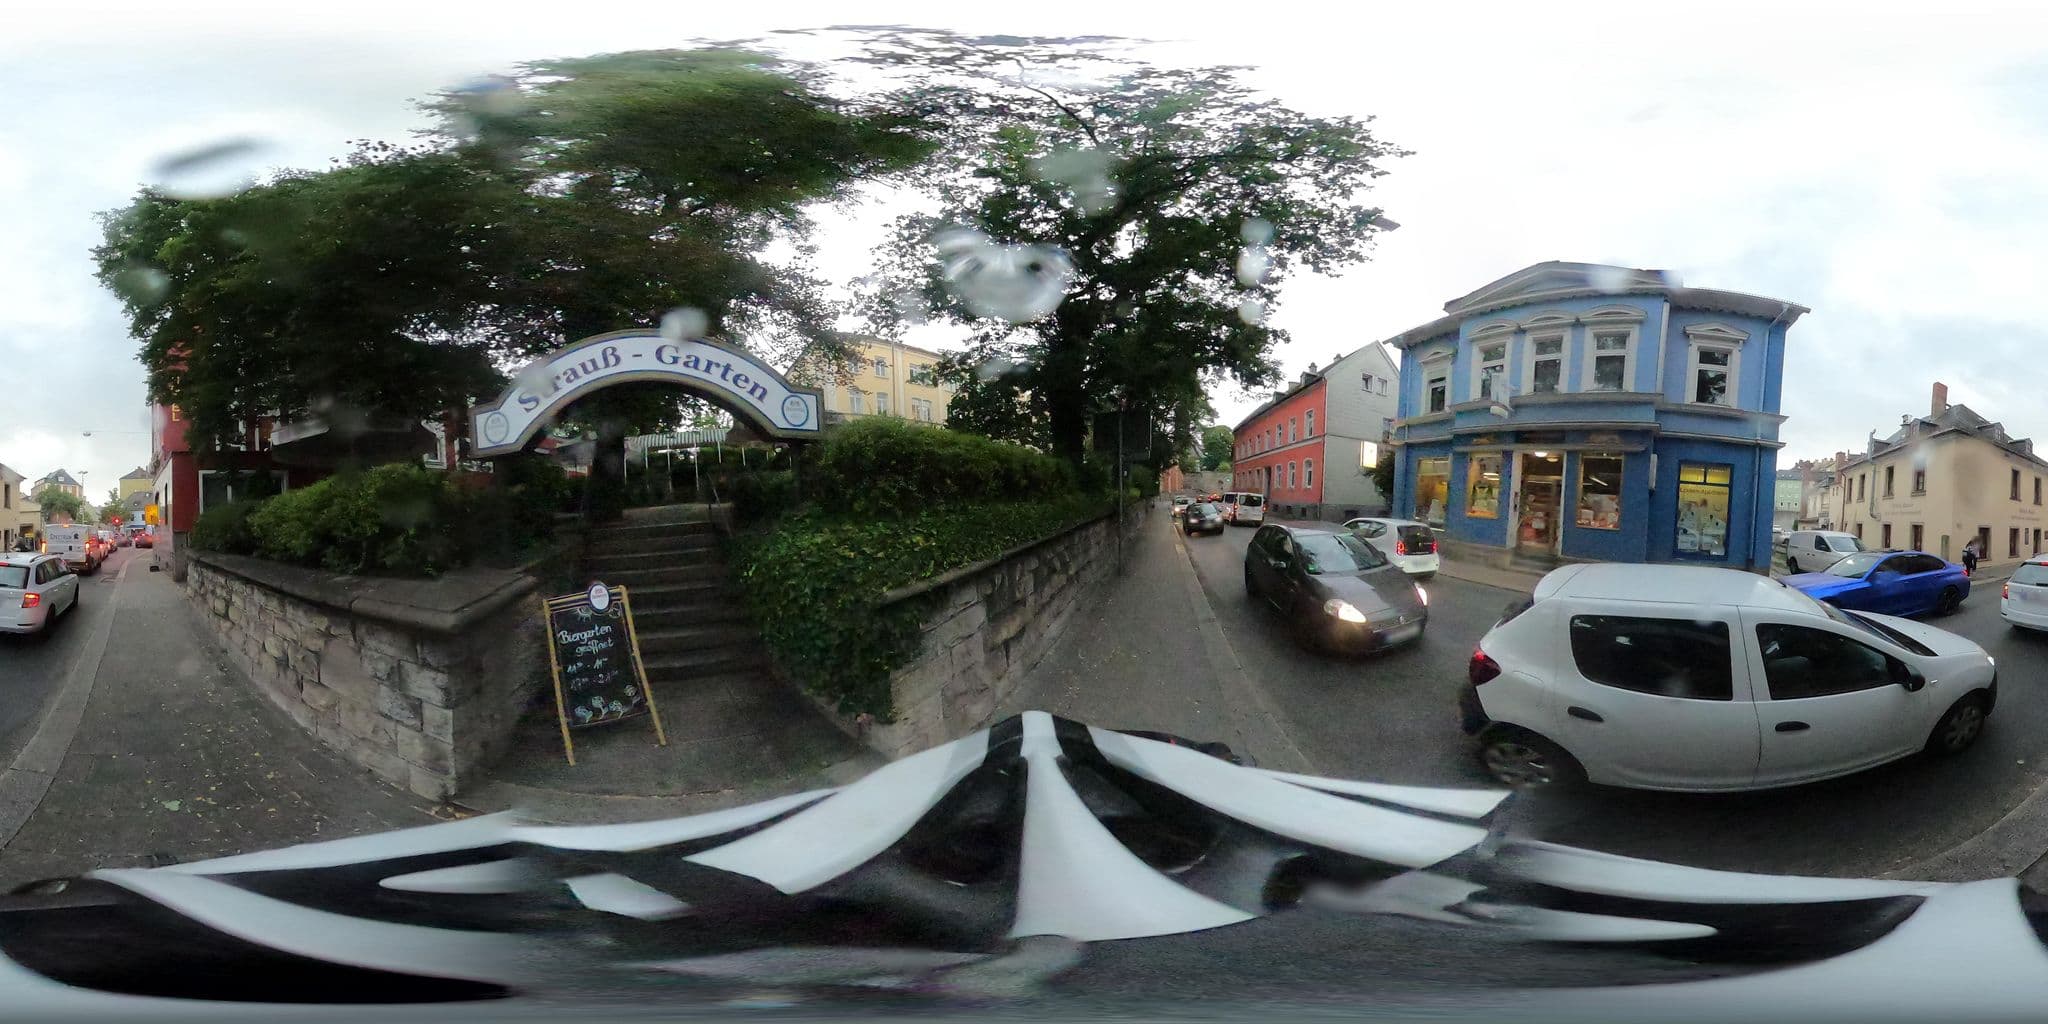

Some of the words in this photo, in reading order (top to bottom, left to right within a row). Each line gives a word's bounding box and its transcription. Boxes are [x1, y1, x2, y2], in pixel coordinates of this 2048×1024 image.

[518, 346, 622, 413] Srauß
[655, 344, 768, 403] Garten
[557, 624, 612, 644] Biergarten
[575, 637, 614, 657] geöffnet
